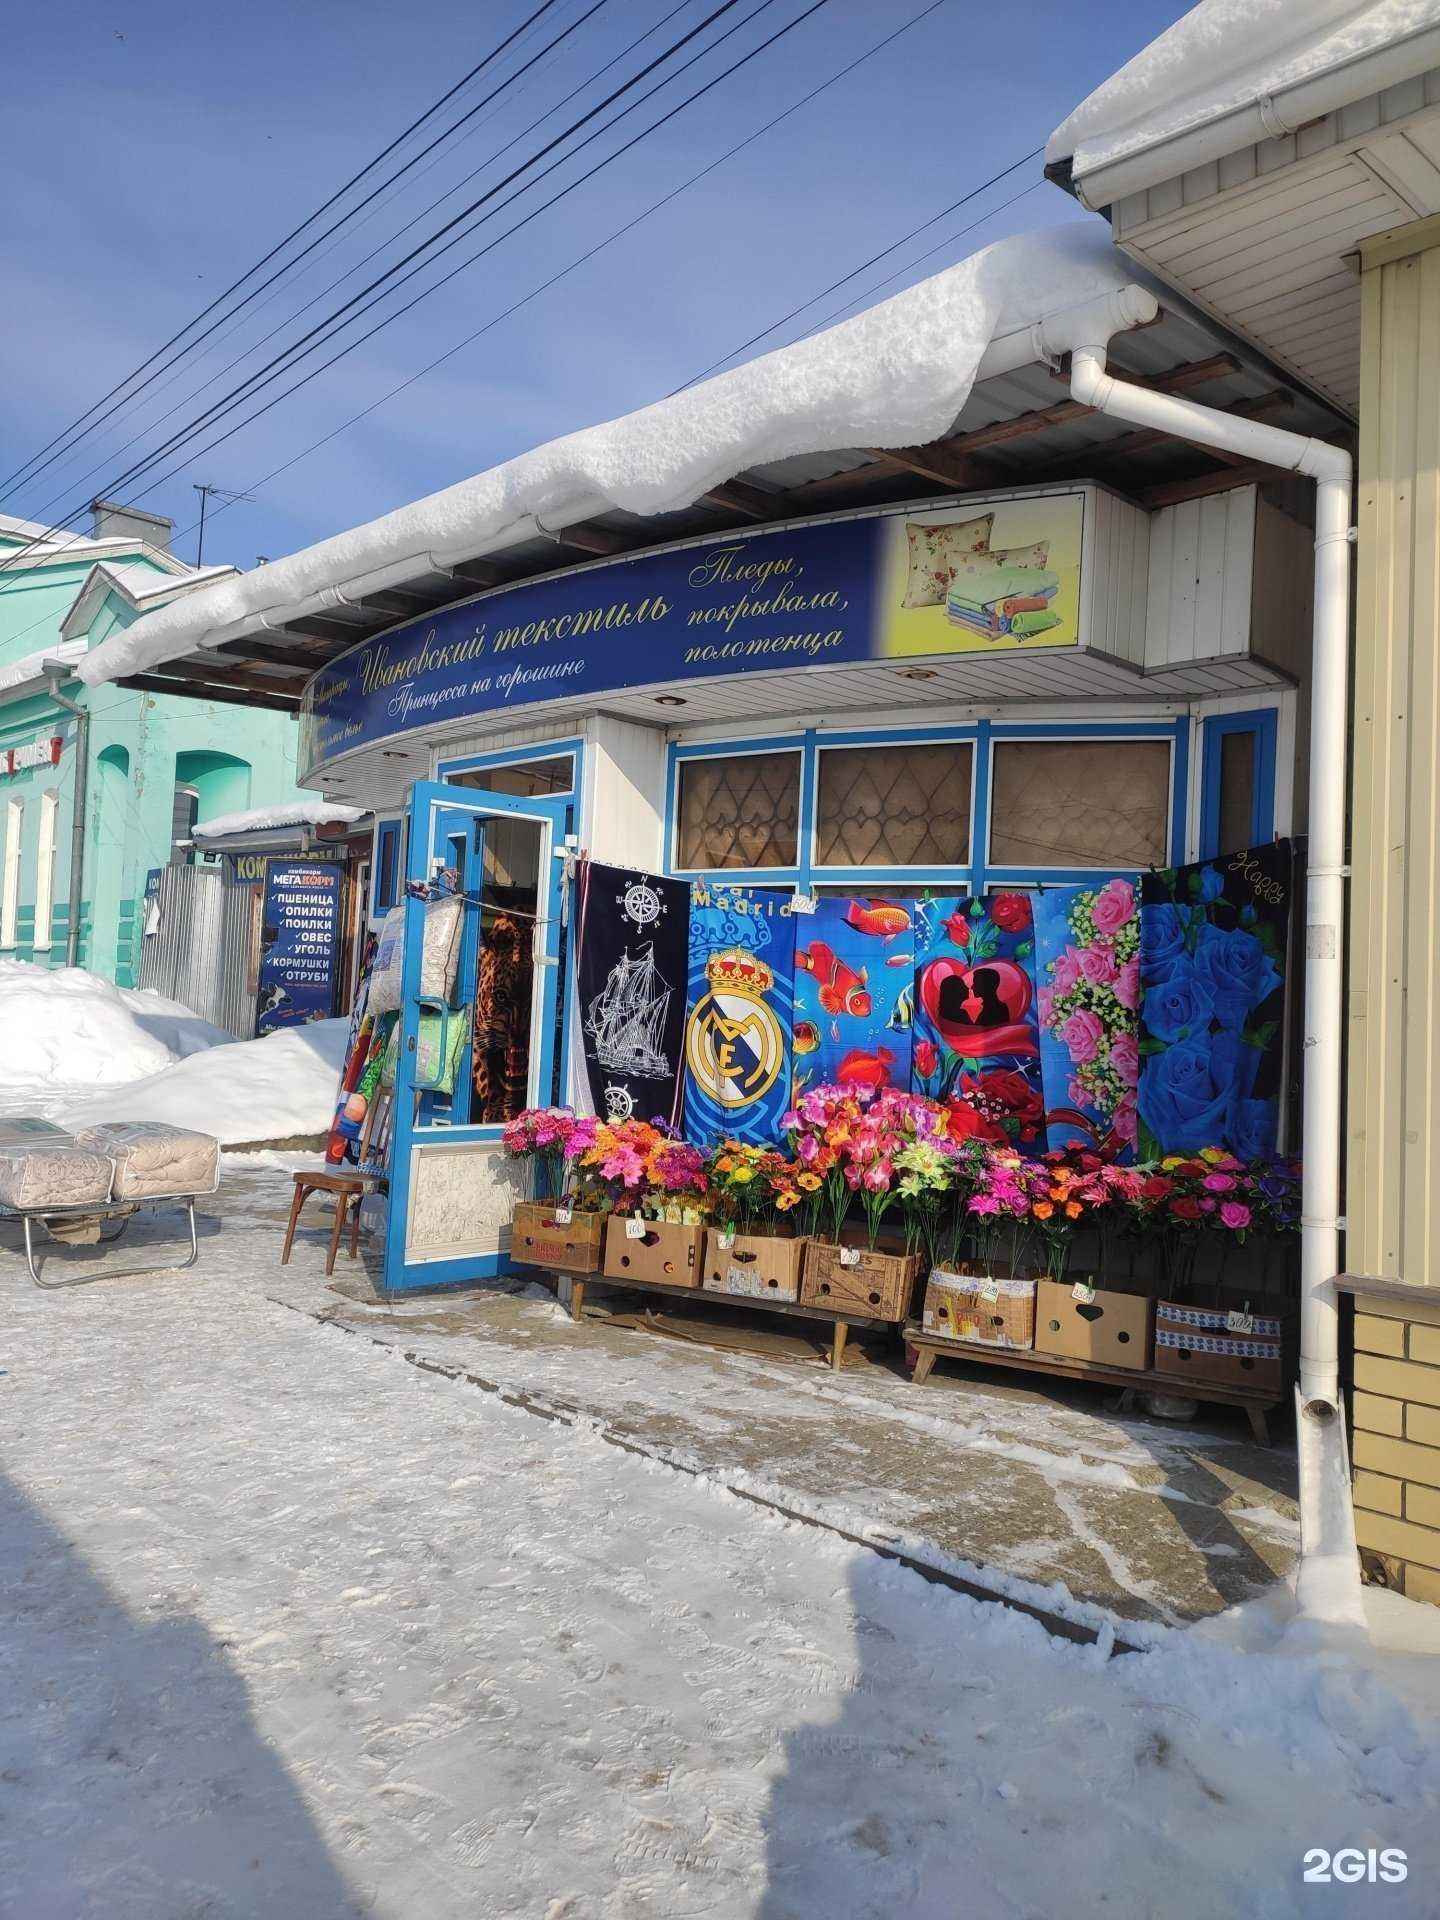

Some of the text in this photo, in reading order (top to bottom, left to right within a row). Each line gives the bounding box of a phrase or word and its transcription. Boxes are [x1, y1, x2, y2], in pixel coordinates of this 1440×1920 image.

[688, 545, 803, 593] Пледы,
[687, 581, 848, 632] покрывала,
[357, 596, 673, 696] Ивановский текстиль
[684, 629, 845, 663] полотенца
[387, 681, 467, 723] Принцесса
[471, 678, 491, 693] на
[496, 657, 585, 698] горошине
[1228, 850, 1284, 904] Happy
[278, 893, 334, 905] ПШЕНИЦА
[693, 890, 791, 917] Madrid
[285, 906, 332, 917] ОПИЛКИ
[285, 919, 332, 929] ПОИЛКИ
[301, 932, 332, 942] ОВЕС
[294, 945, 330, 955] УГОЛЬ
[273, 957, 329, 969] КОРМУШКИ
[286, 971, 329, 982] ОТРУБИ
